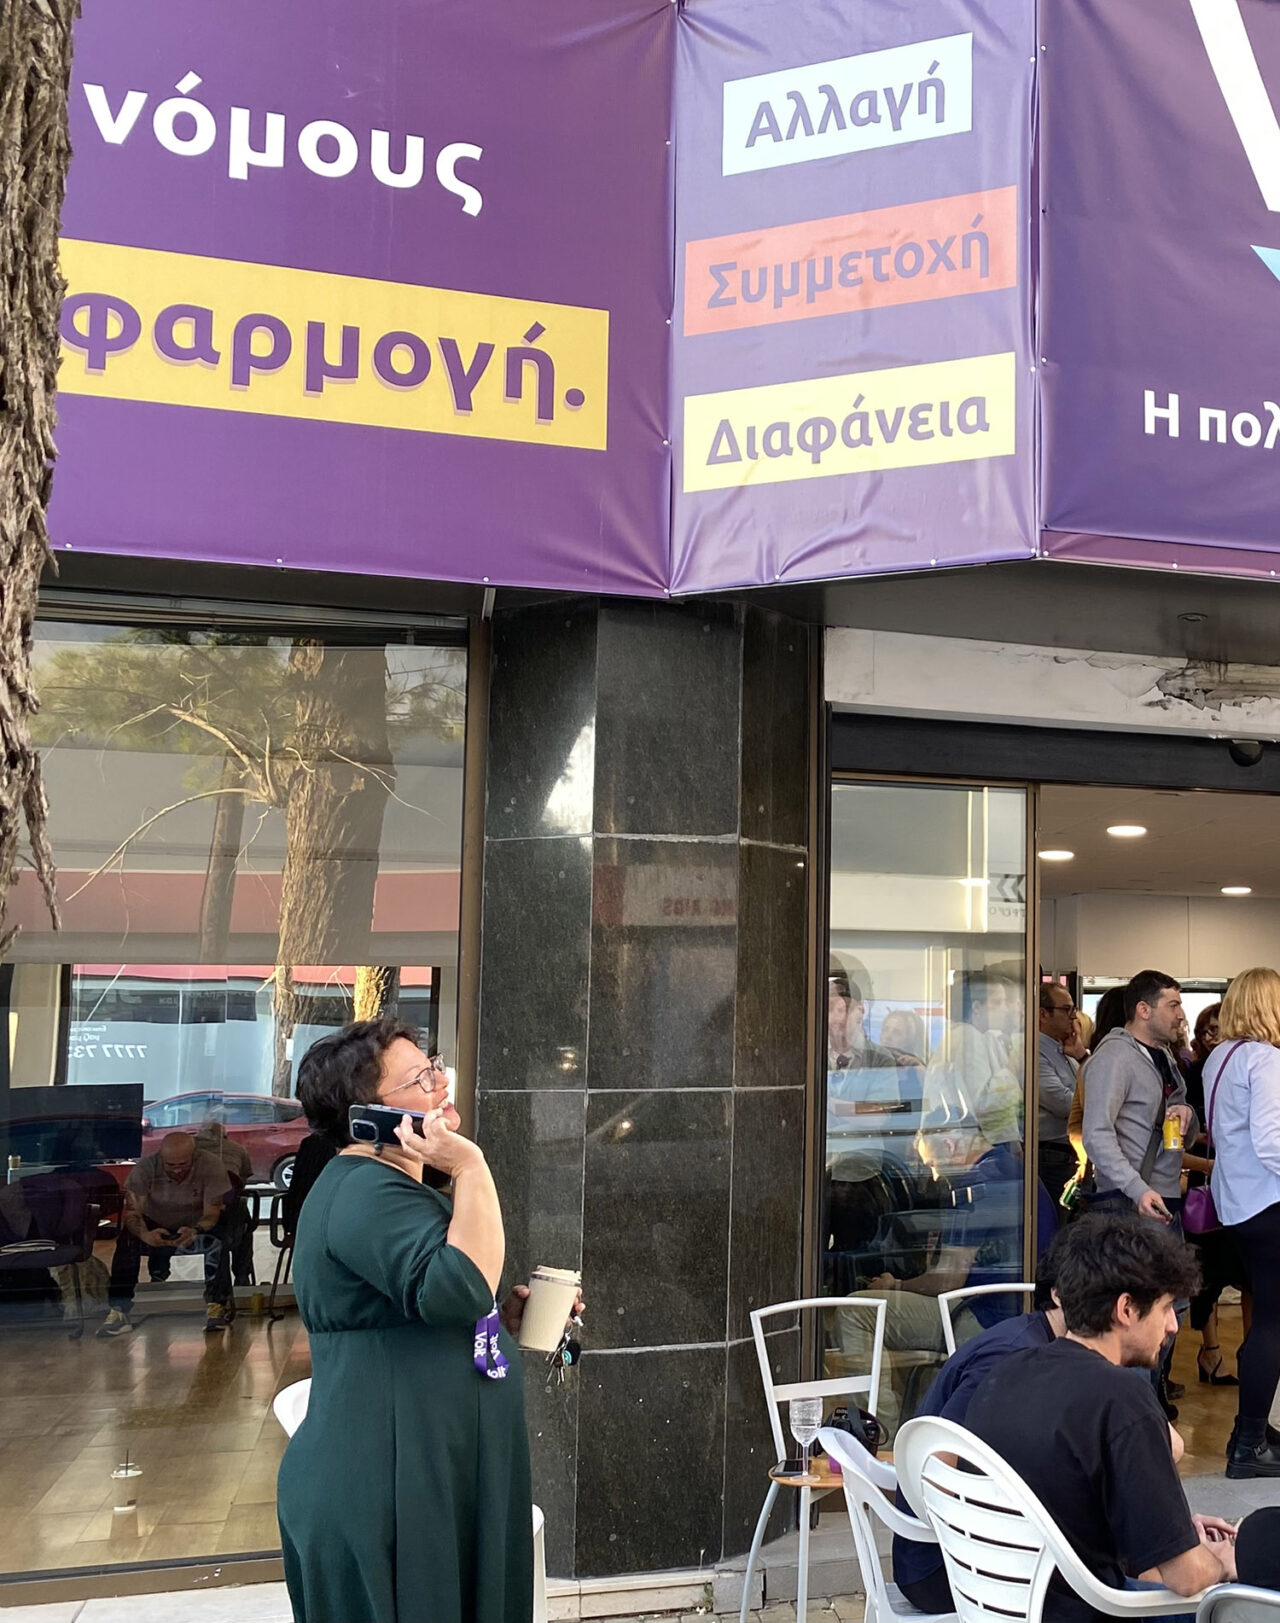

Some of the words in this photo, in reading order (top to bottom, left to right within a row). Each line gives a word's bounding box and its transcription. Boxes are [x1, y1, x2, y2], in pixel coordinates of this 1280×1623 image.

[83, 70, 484, 217] νόμους
[745, 60, 946, 148] Αλλαγή
[707, 213, 991, 309] Συμμετοχή
[706, 394, 990, 466] Διαφάνεια
[1143, 390, 1180, 437] Η
[474, 1331, 488, 1358] Volt
